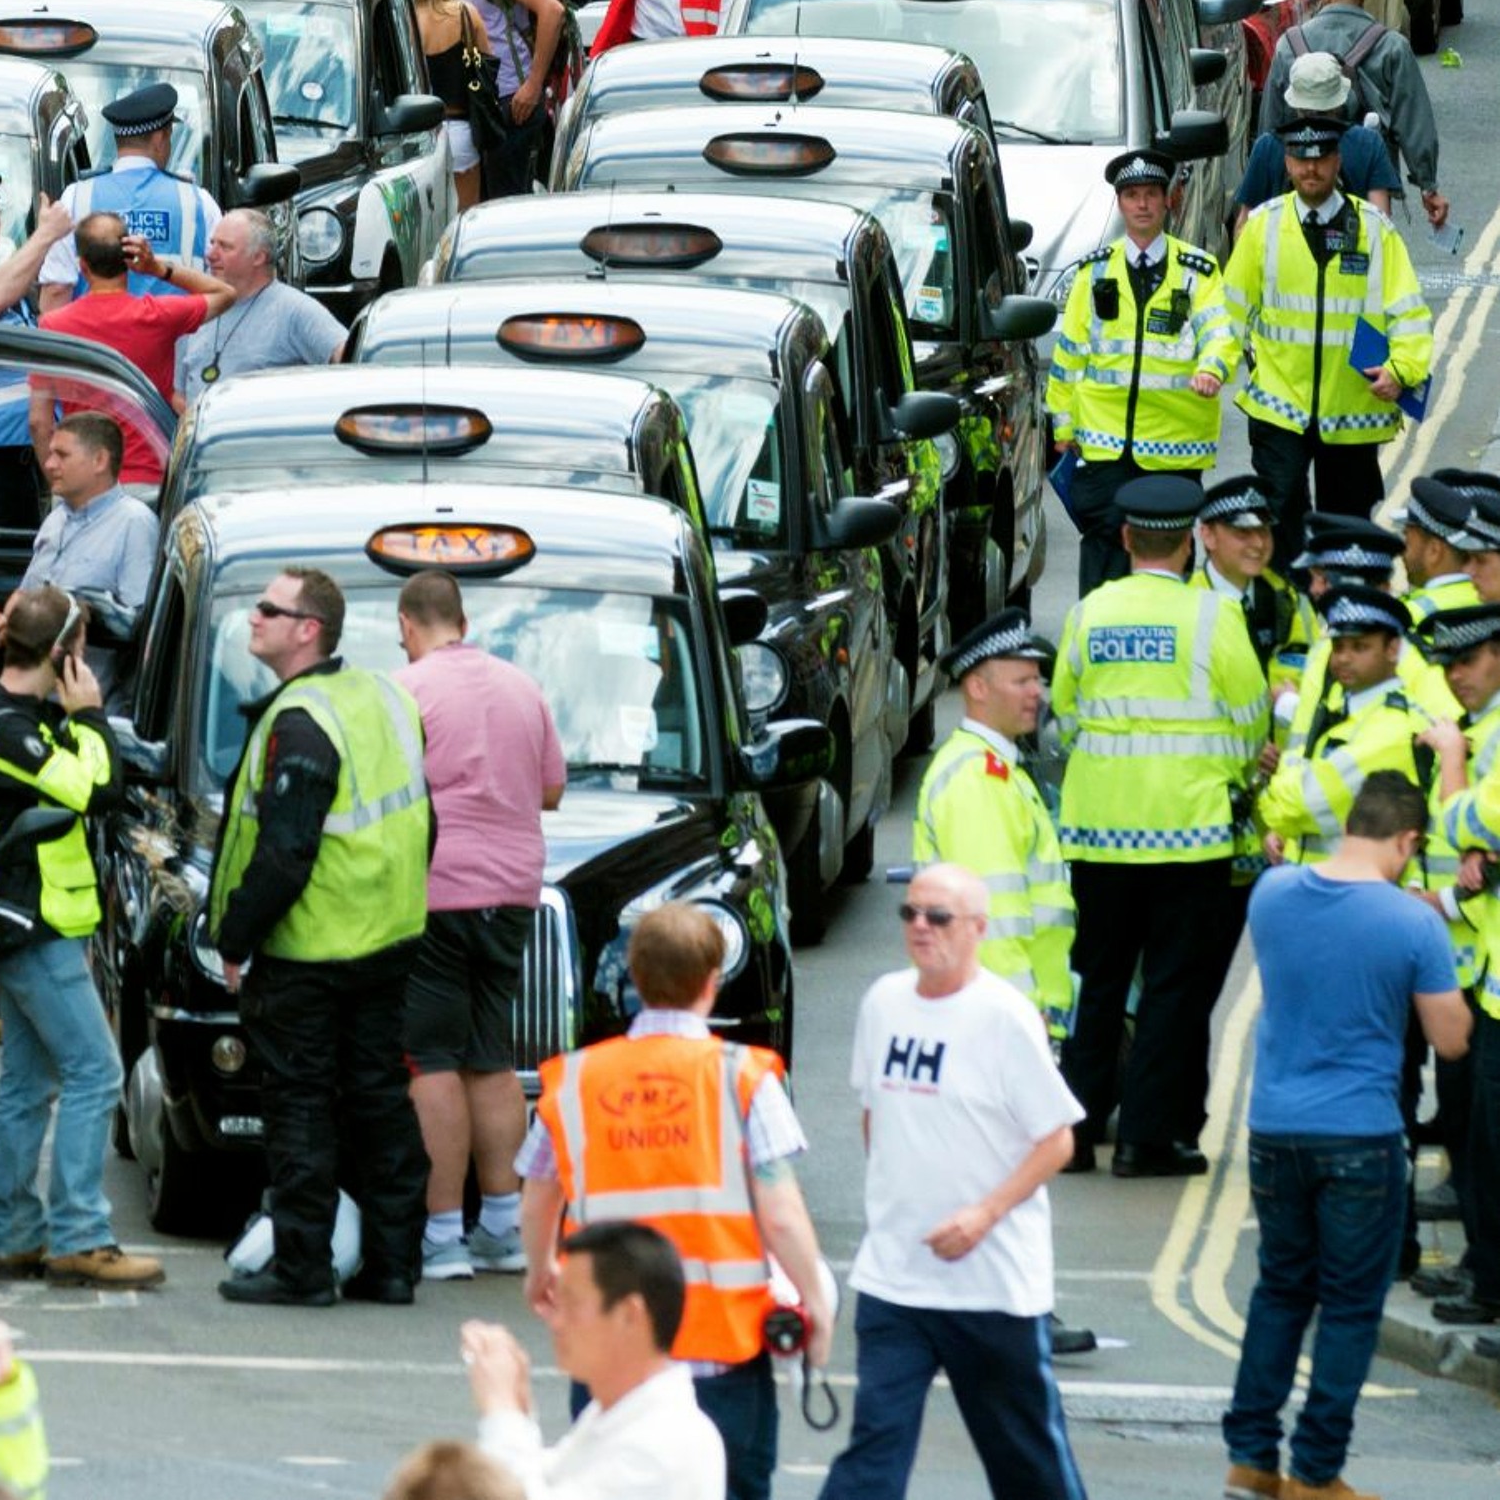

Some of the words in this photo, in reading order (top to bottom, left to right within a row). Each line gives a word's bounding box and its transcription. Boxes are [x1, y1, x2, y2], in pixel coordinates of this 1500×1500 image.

[123, 213, 165, 227] OLICE
[530, 322, 617, 344] TAXI
[1090, 639, 1174, 661] POLICE
[883, 1035, 946, 1083] HH
[606, 1123, 690, 1152] UNION
